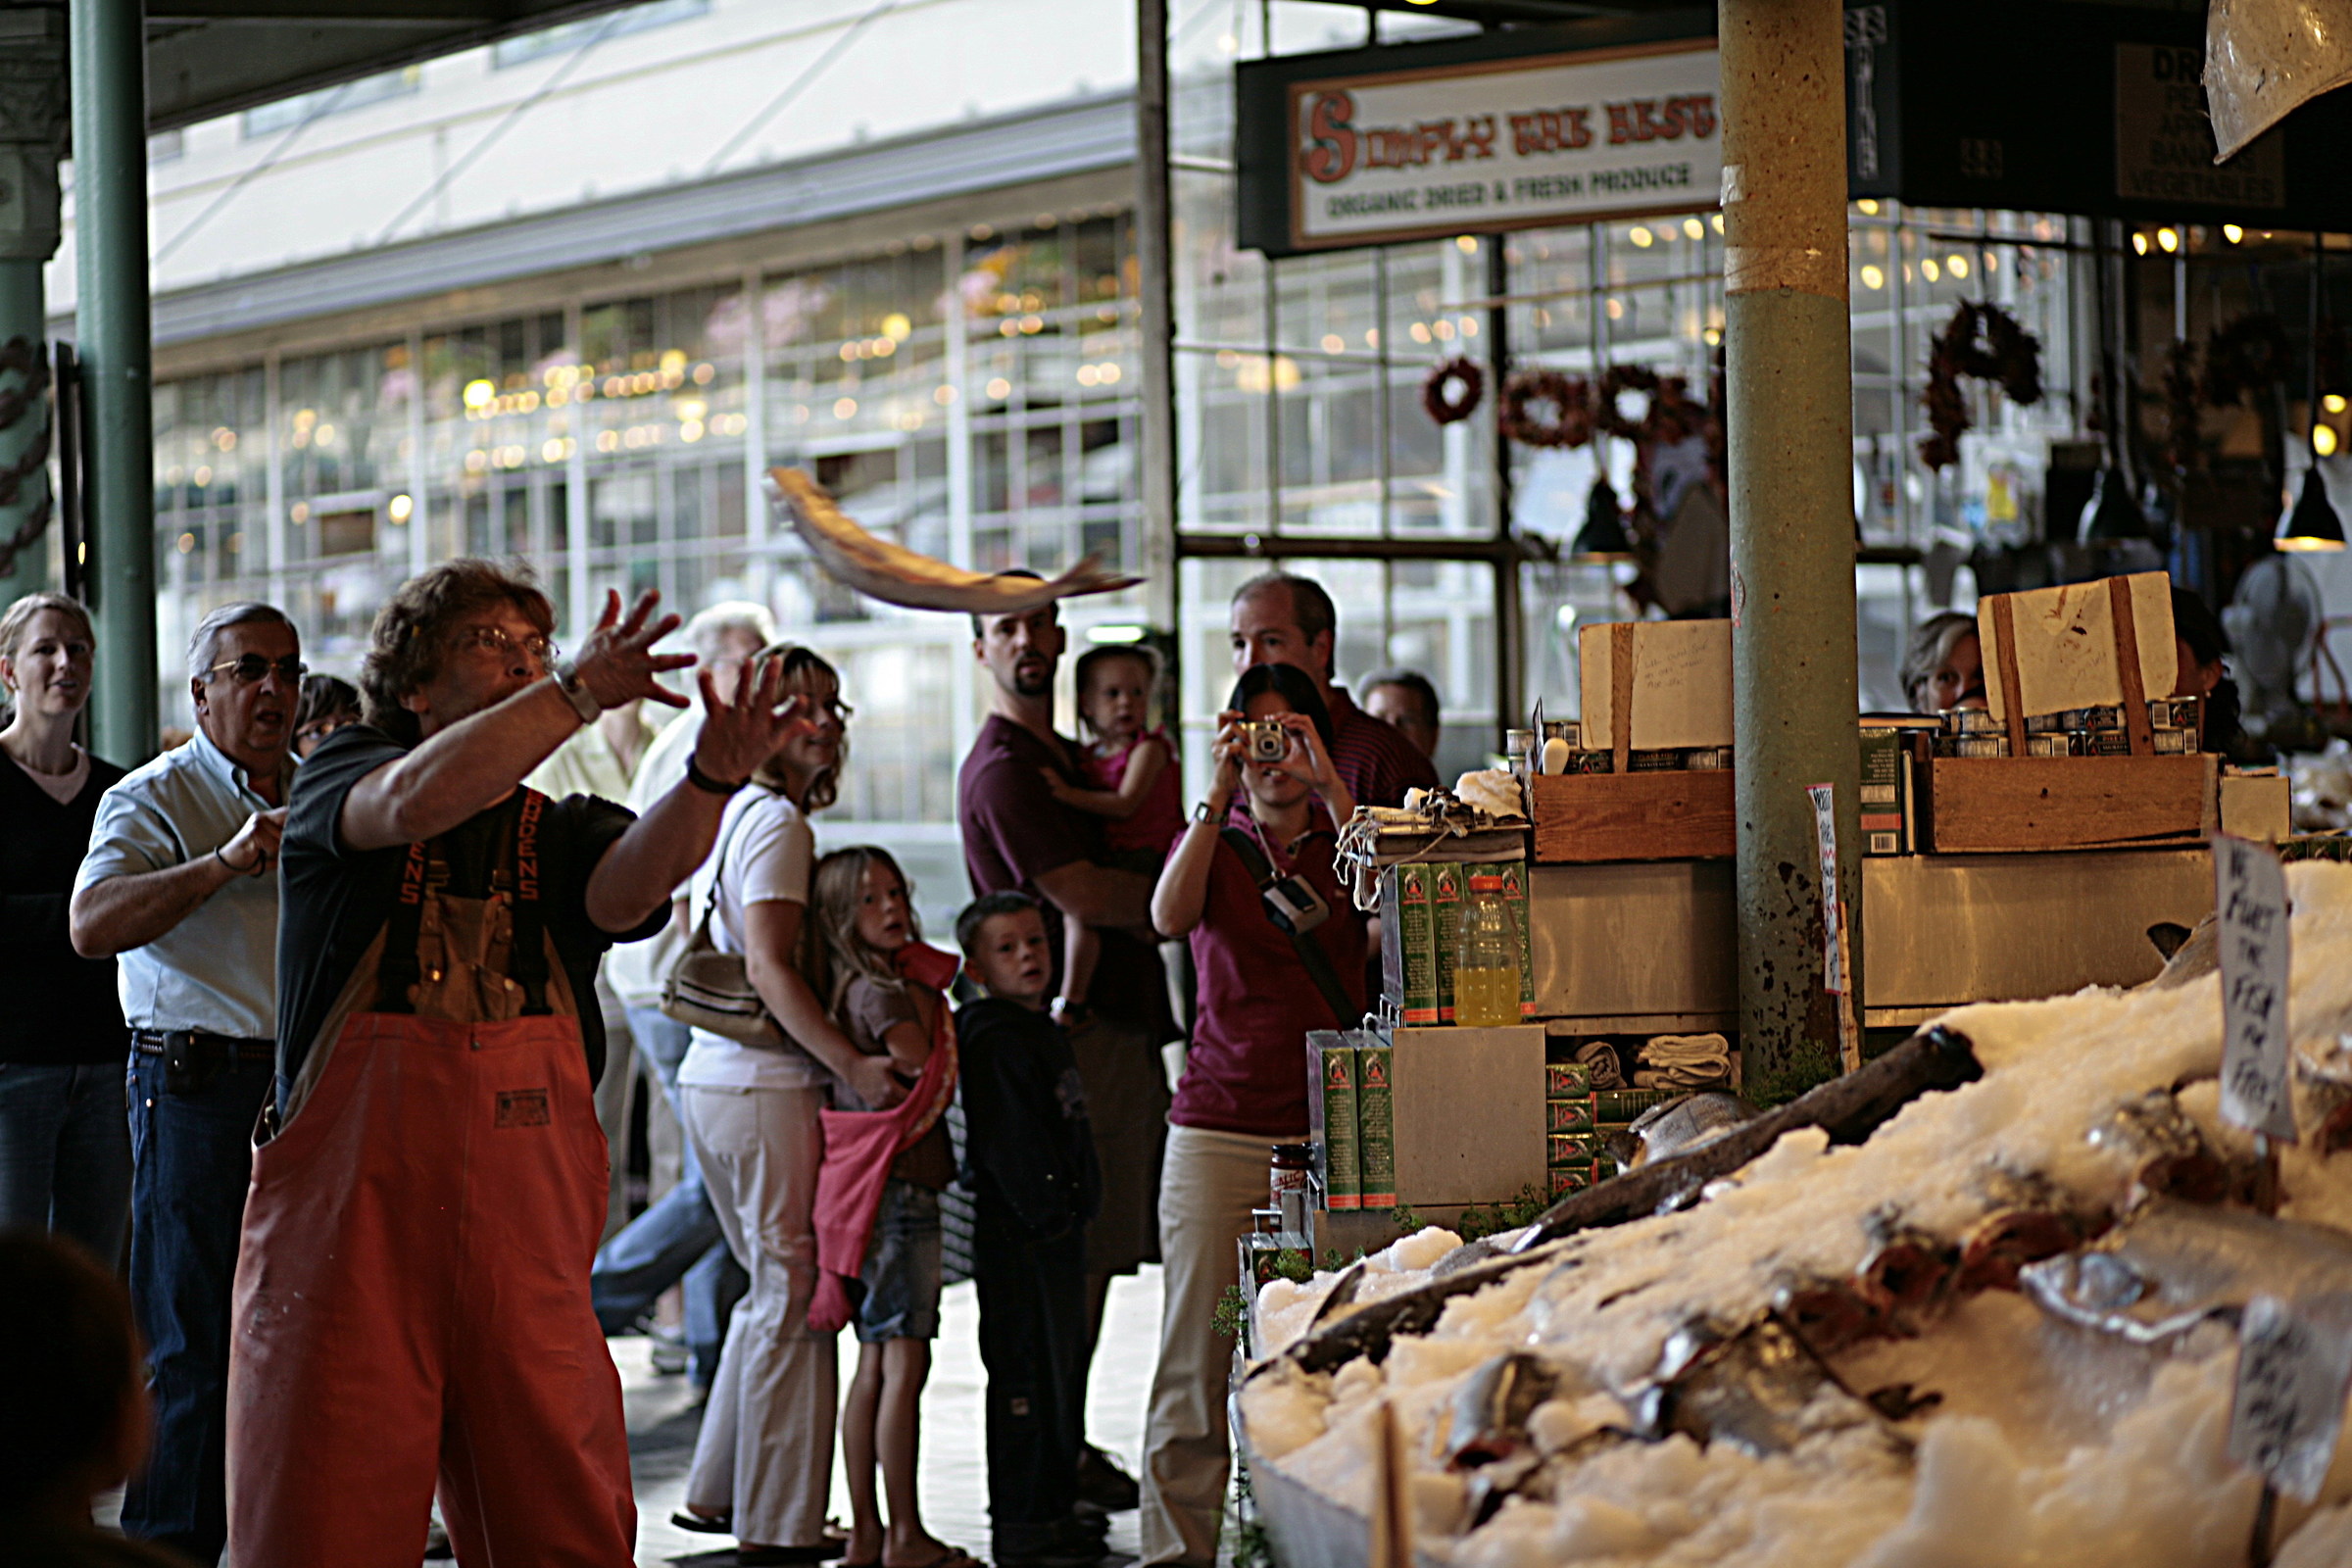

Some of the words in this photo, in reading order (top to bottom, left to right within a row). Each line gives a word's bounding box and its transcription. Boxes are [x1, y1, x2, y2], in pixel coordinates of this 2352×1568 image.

[2155, 47, 2196, 81] DR
[1510, 108, 1592, 155] THE
[1607, 95, 1717, 144] BEST
[1327, 193, 1417, 217] ORGANIC
[1425, 185, 1485, 208] DRIED
[1495, 183, 1508, 202] &
[1514, 176, 1583, 201] FRESH
[1591, 164, 1691, 192] PRODUCE
[400, 842, 426, 905] ENS
